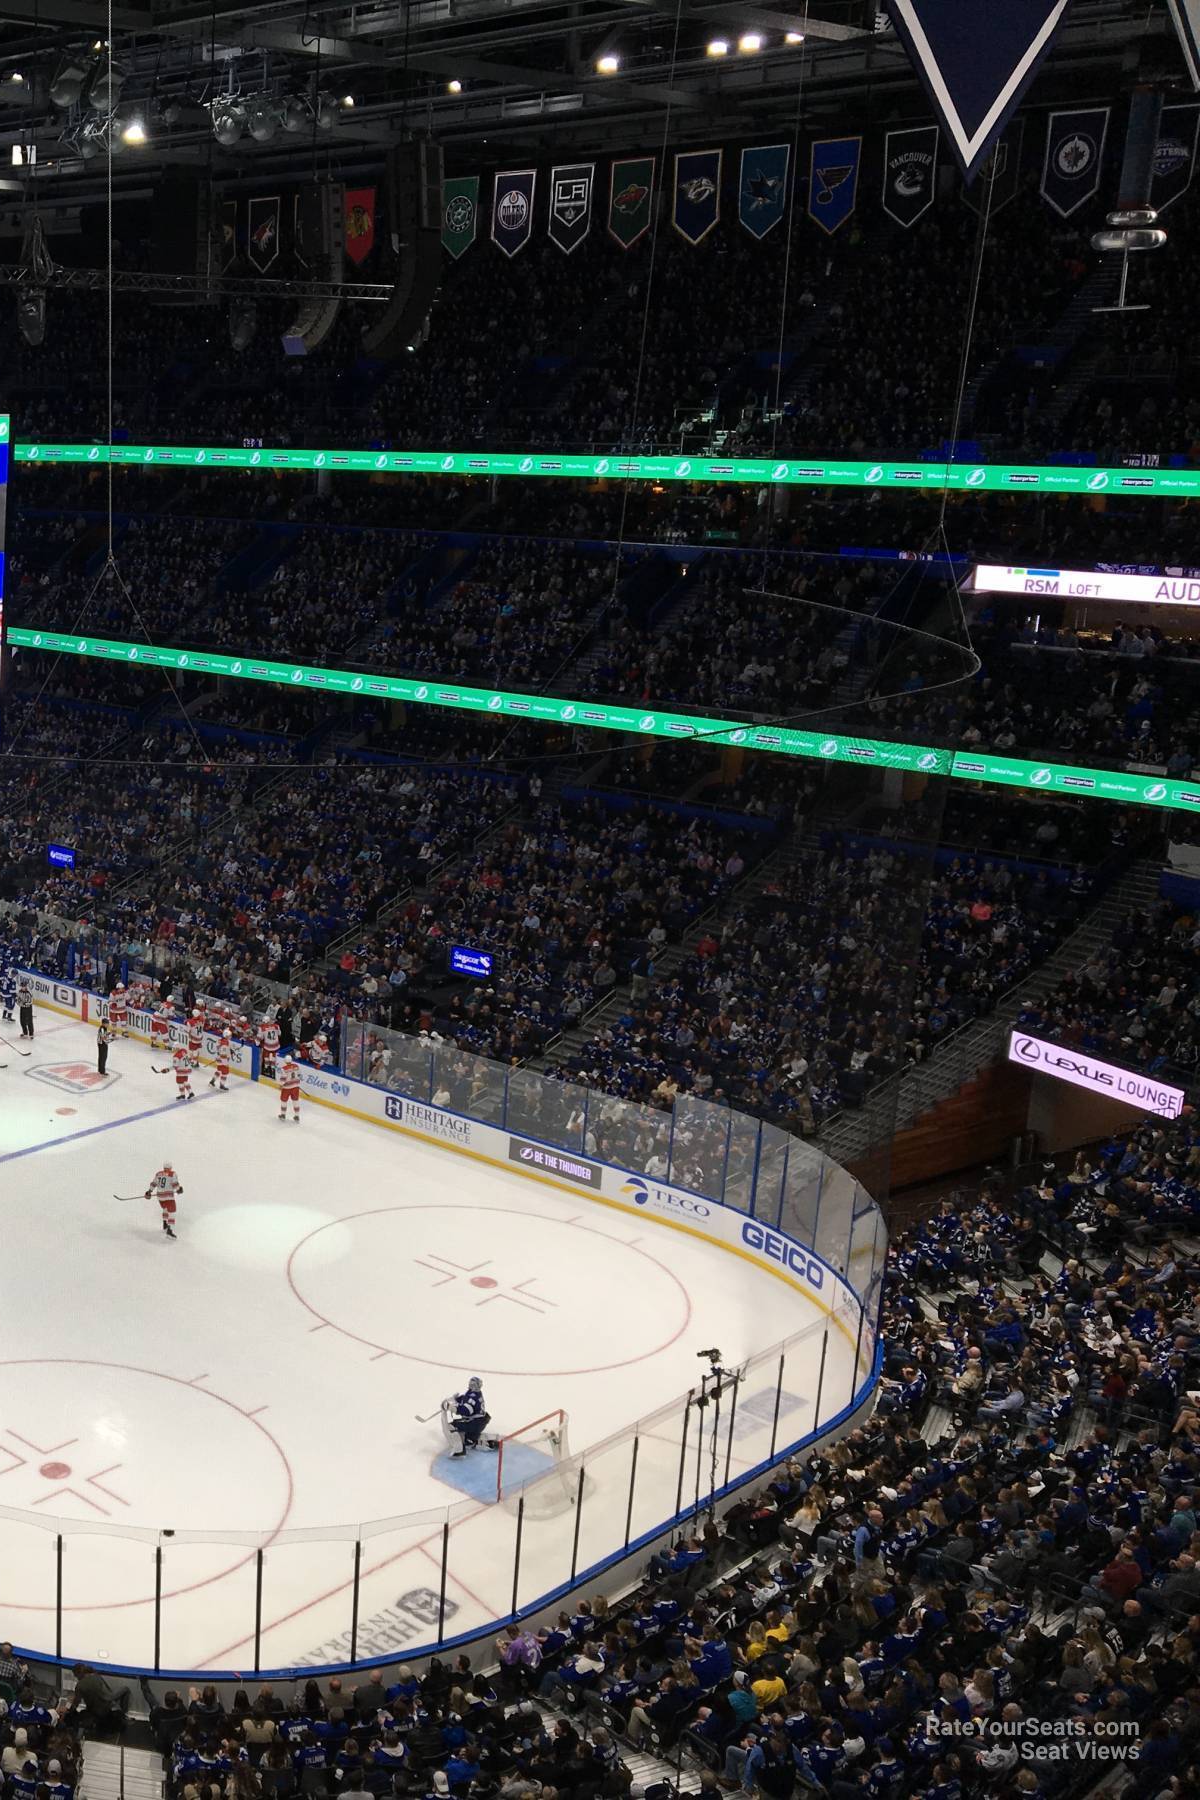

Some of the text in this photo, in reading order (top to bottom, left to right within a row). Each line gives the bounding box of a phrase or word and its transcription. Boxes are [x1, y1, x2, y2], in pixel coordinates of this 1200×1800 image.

[888, 152, 932, 169] VANCOUVER
[558, 184, 586, 200] LA
[502, 205, 525, 216] OILERS
[1024, 579, 1102, 596] RSM LOFT
[34, 981, 49, 994] SUN
[306, 1073, 328, 1089] Blue
[1044, 1052, 1178, 1109] LEXUS LOUNGE
[405, 1102, 471, 1134] HERITAGE
[403, 1115, 471, 1145] INSURANCE
[534, 1151, 591, 1181] BE THE THUNDER
[653, 1188, 710, 1217] TECO
[742, 1222, 824, 1290] GEICO
